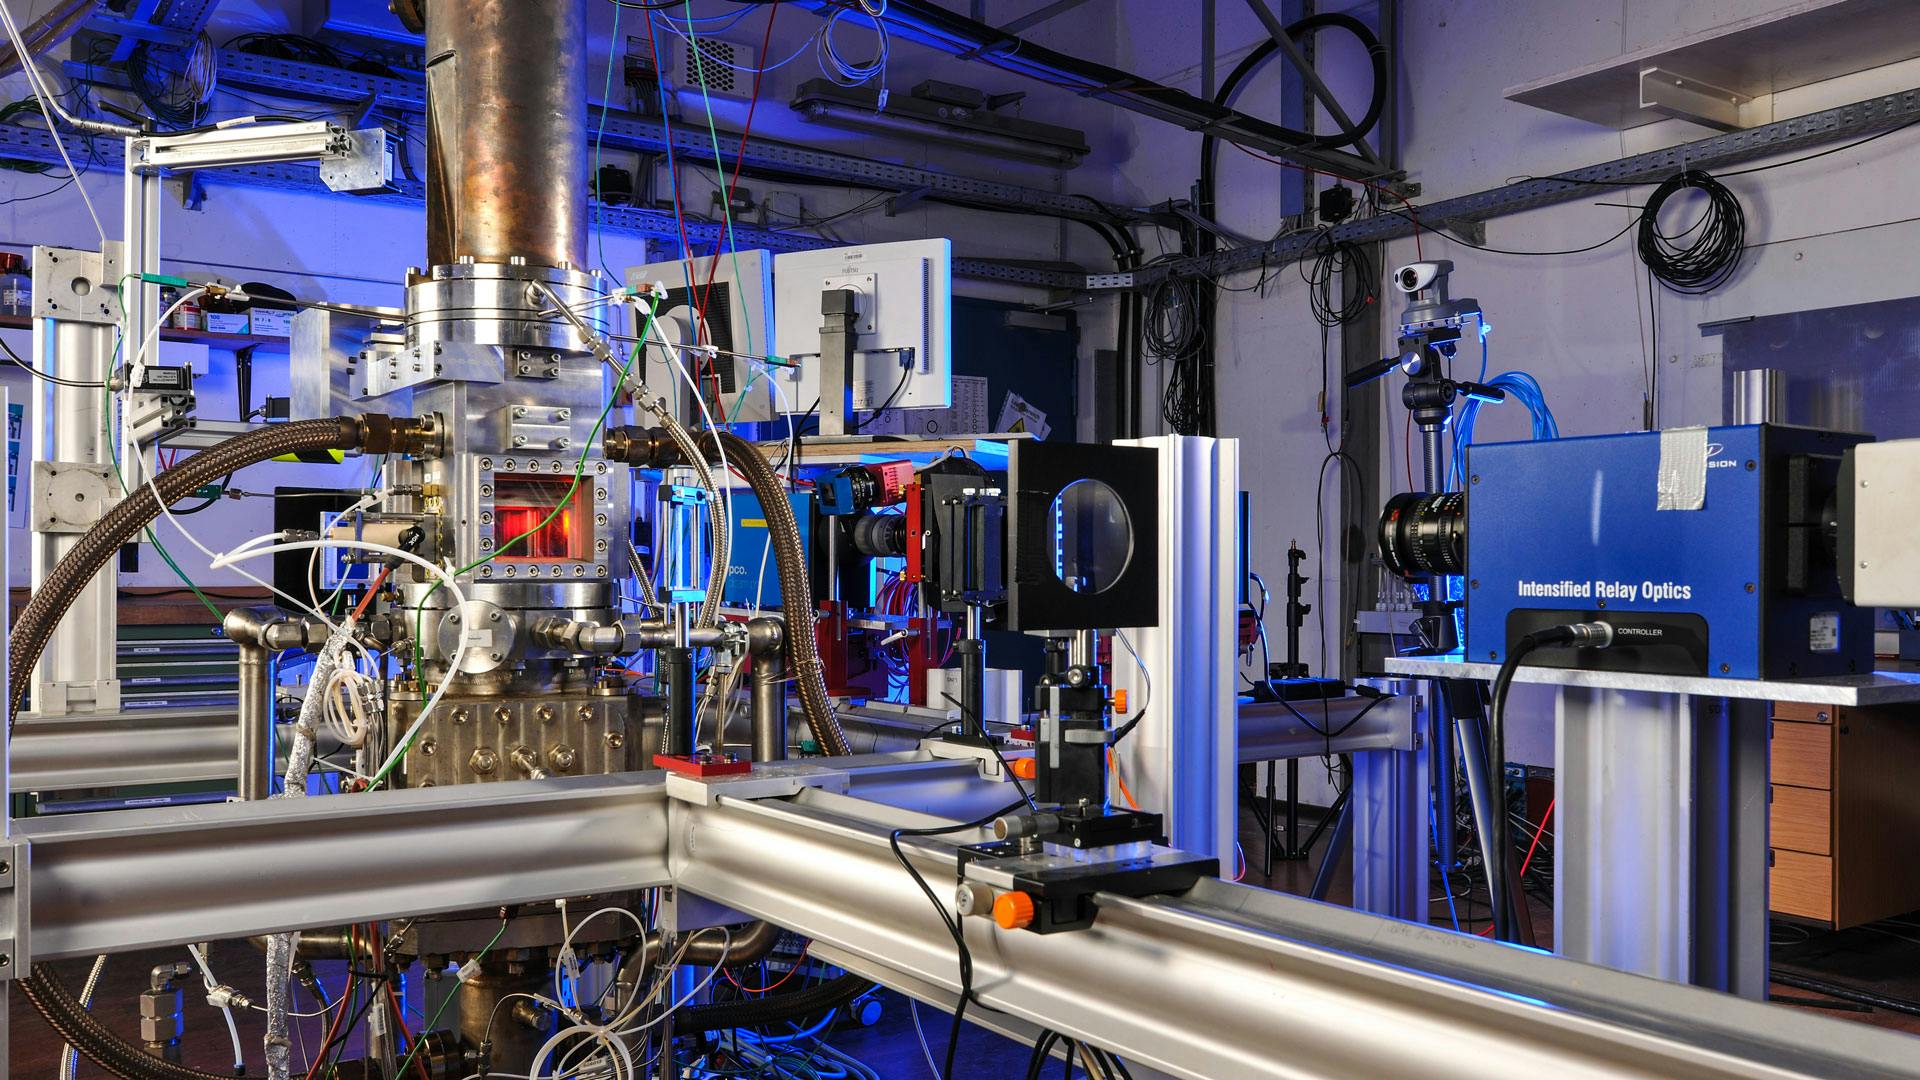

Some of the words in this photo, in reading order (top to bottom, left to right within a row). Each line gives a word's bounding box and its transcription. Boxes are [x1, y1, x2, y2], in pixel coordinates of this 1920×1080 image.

[1708, 460, 1737, 469] SION
[1518, 580, 1591, 598] Intensified
[1595, 581, 1638, 602] Relay
[1642, 581, 1692, 603] Optics
[1618, 627, 1663, 637] CONTROLLER
